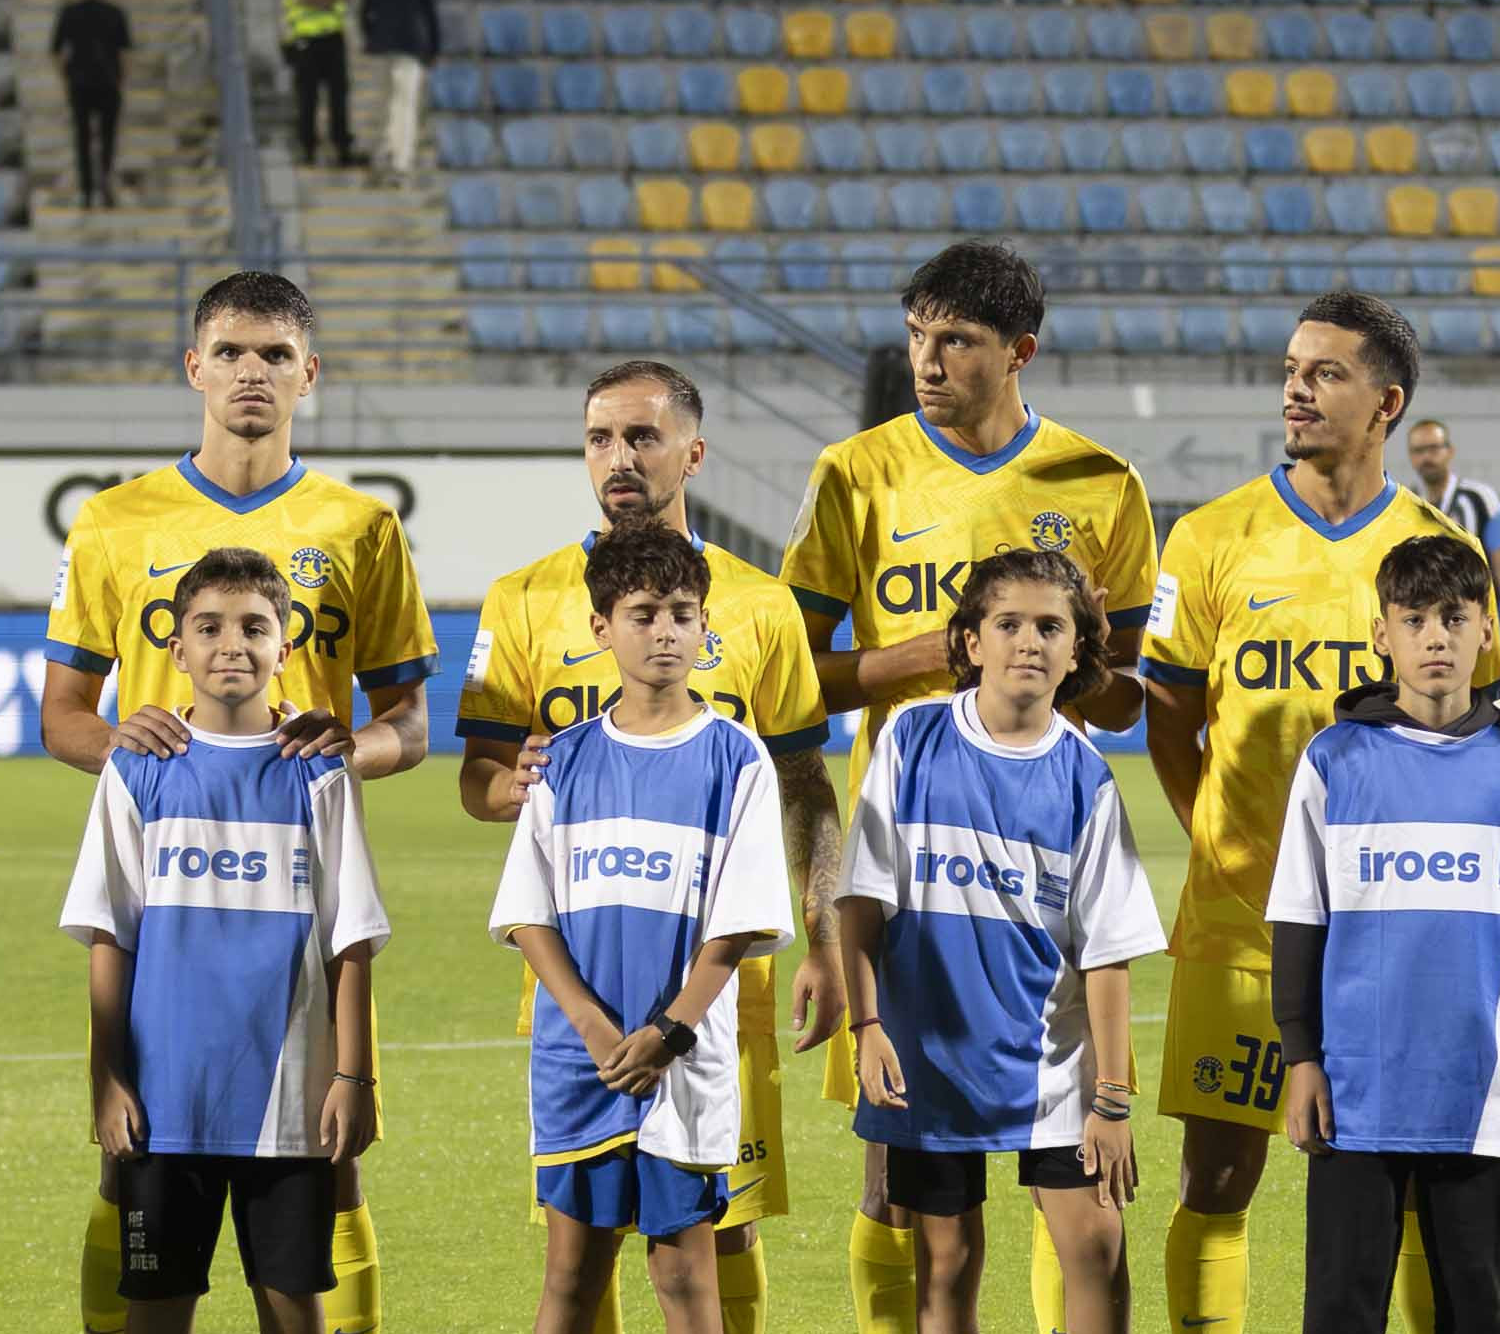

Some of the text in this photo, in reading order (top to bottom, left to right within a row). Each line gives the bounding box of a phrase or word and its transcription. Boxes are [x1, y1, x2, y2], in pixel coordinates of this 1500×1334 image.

[914, 846, 1025, 898] iroes
[1358, 846, 1481, 884] iroes
[1234, 1034, 1286, 1112] 39
